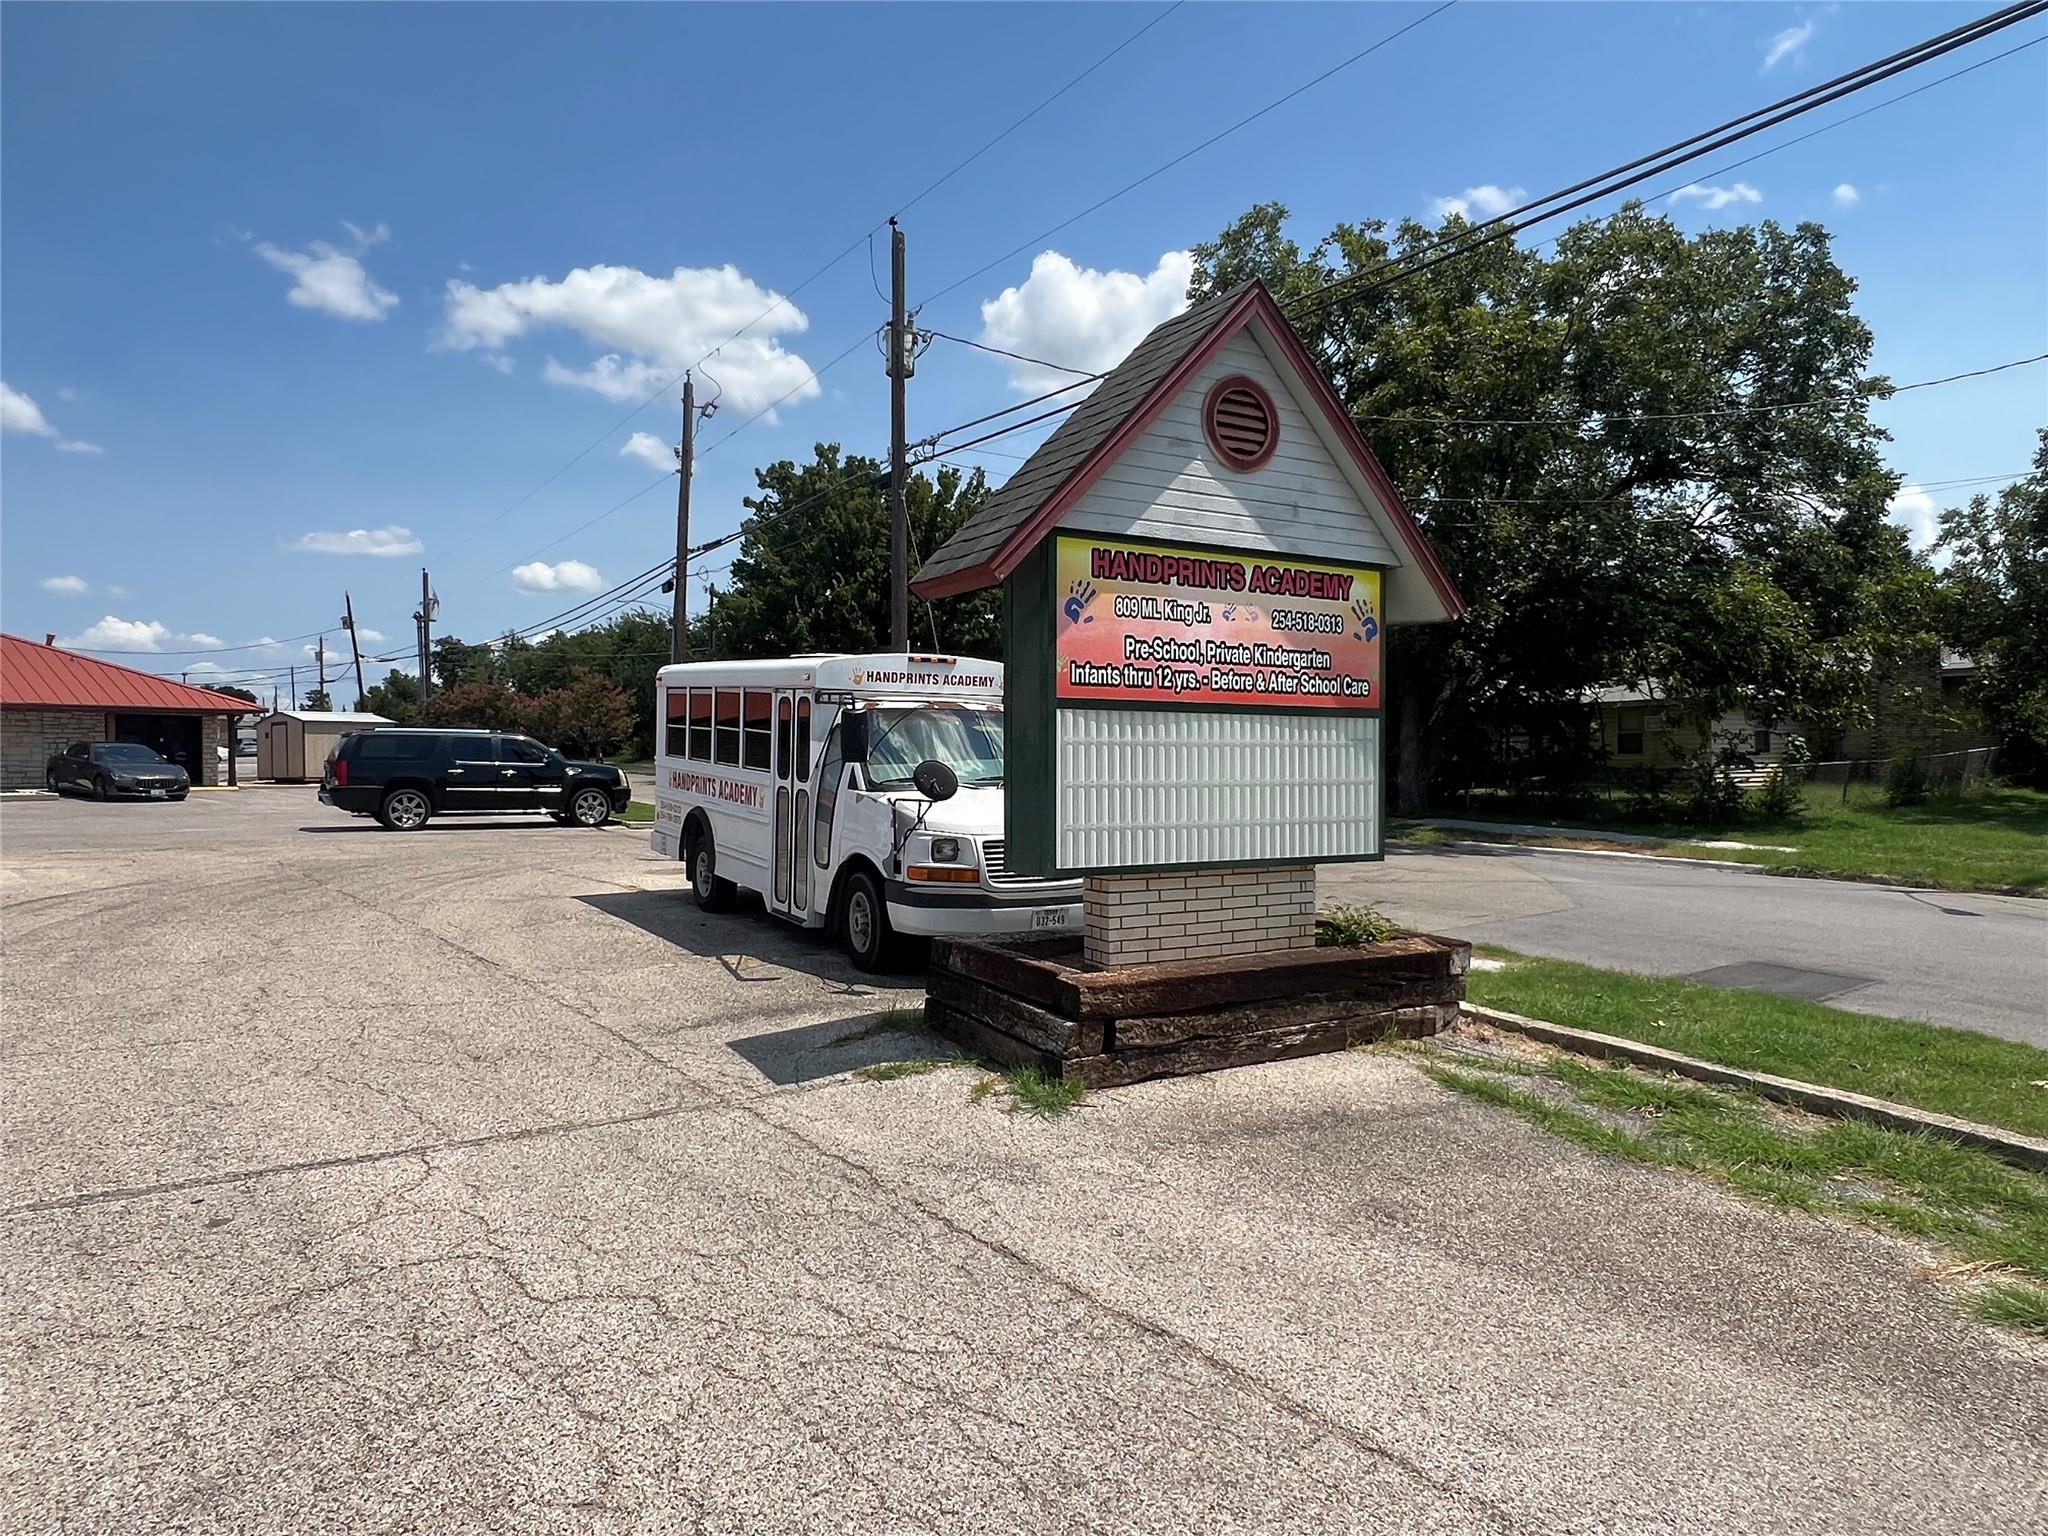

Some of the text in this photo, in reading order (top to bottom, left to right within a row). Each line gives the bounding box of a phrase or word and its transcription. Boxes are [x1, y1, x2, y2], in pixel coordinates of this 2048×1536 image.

[1093, 549, 1353, 600] HANDPRINTS ACADEMY
[1115, 597, 1211, 624] 809 ML King Jr.
[1272, 611, 1343, 633] 254-518-0313
[1125, 638, 1330, 670] Pre-School, Private Kindergarten
[866, 671, 995, 687] HANDPRINTS ACADEMY
[1071, 663, 1120, 684] Infants
[1124, 666, 1152, 686] thru
[1156, 668, 1172, 687] 12
[1174, 672, 1200, 692] yrs.
[1211, 670, 1253, 690] Before
[1256, 673, 1267, 690] &
[1268, 673, 1298, 692] After
[1300, 674, 1340, 694] School
[1343, 677, 1369, 695] Care
[672, 771, 758, 807] HANDPRINTS ACADEMY
